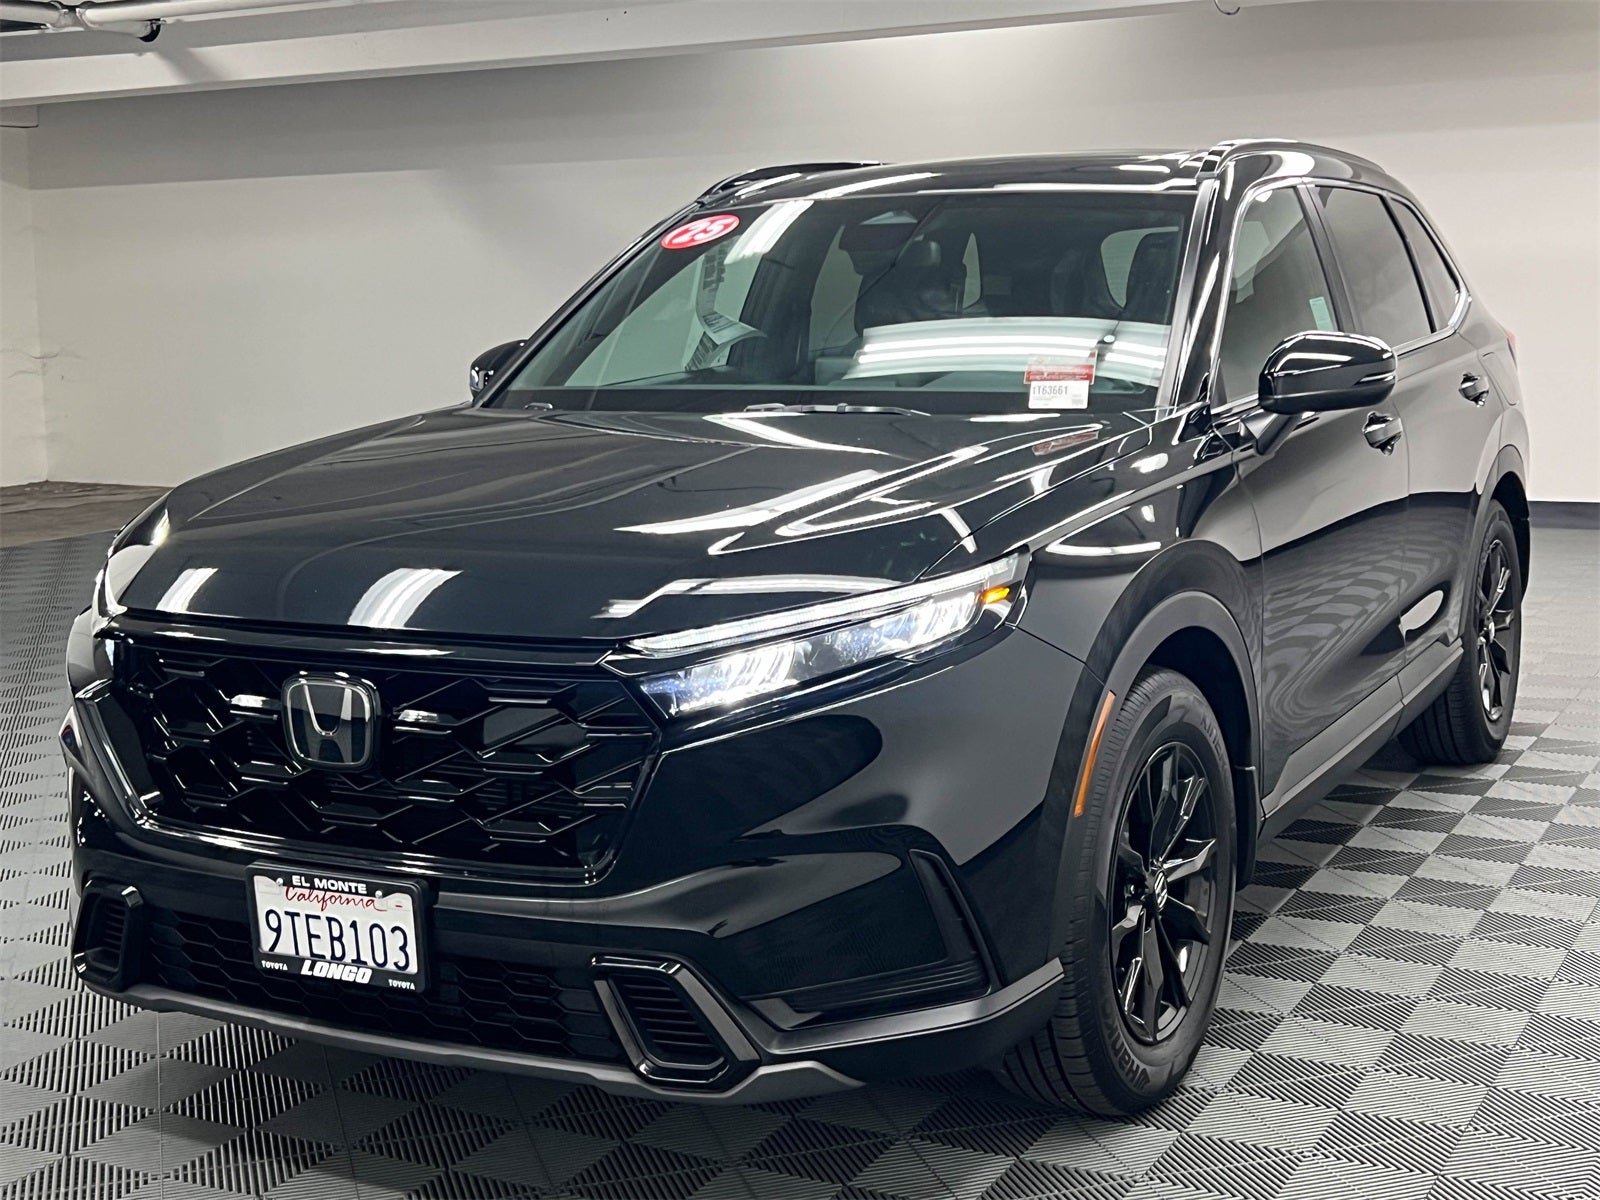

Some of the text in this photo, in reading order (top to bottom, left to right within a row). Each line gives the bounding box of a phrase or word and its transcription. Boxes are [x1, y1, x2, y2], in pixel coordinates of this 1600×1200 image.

[671, 217, 736, 244] 25
[291, 875, 367, 894] EL MONTE
[284, 886, 388, 911] California
[265, 909, 410, 972] 9TEB103
[261, 960, 288, 971] TOYOTA
[300, 959, 373, 984] LONGO
[388, 979, 415, 990] TOYOTA
